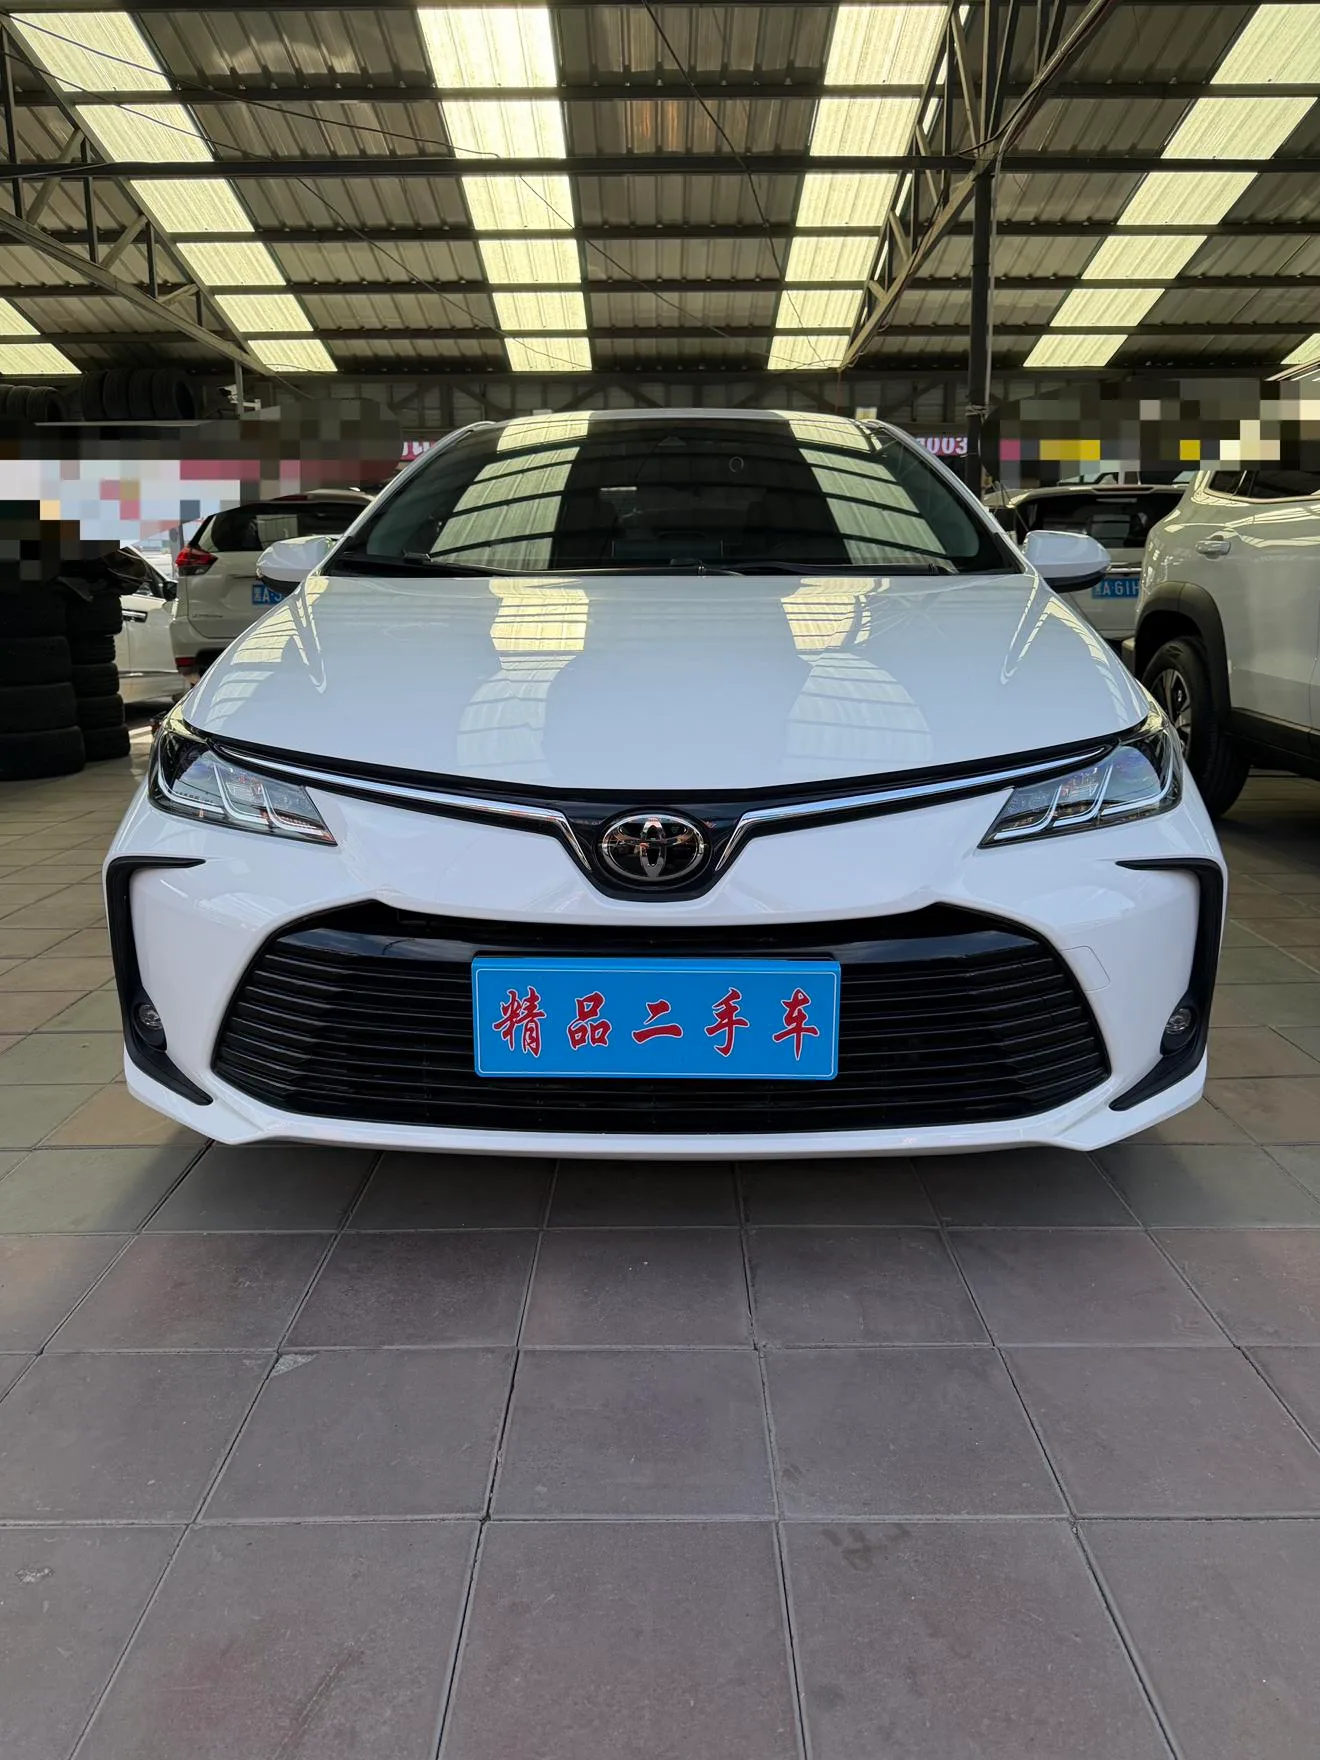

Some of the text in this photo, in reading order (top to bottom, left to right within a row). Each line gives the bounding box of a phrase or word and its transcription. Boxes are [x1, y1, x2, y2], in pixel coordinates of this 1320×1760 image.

[492, 986, 820, 1060] 精品二手车
